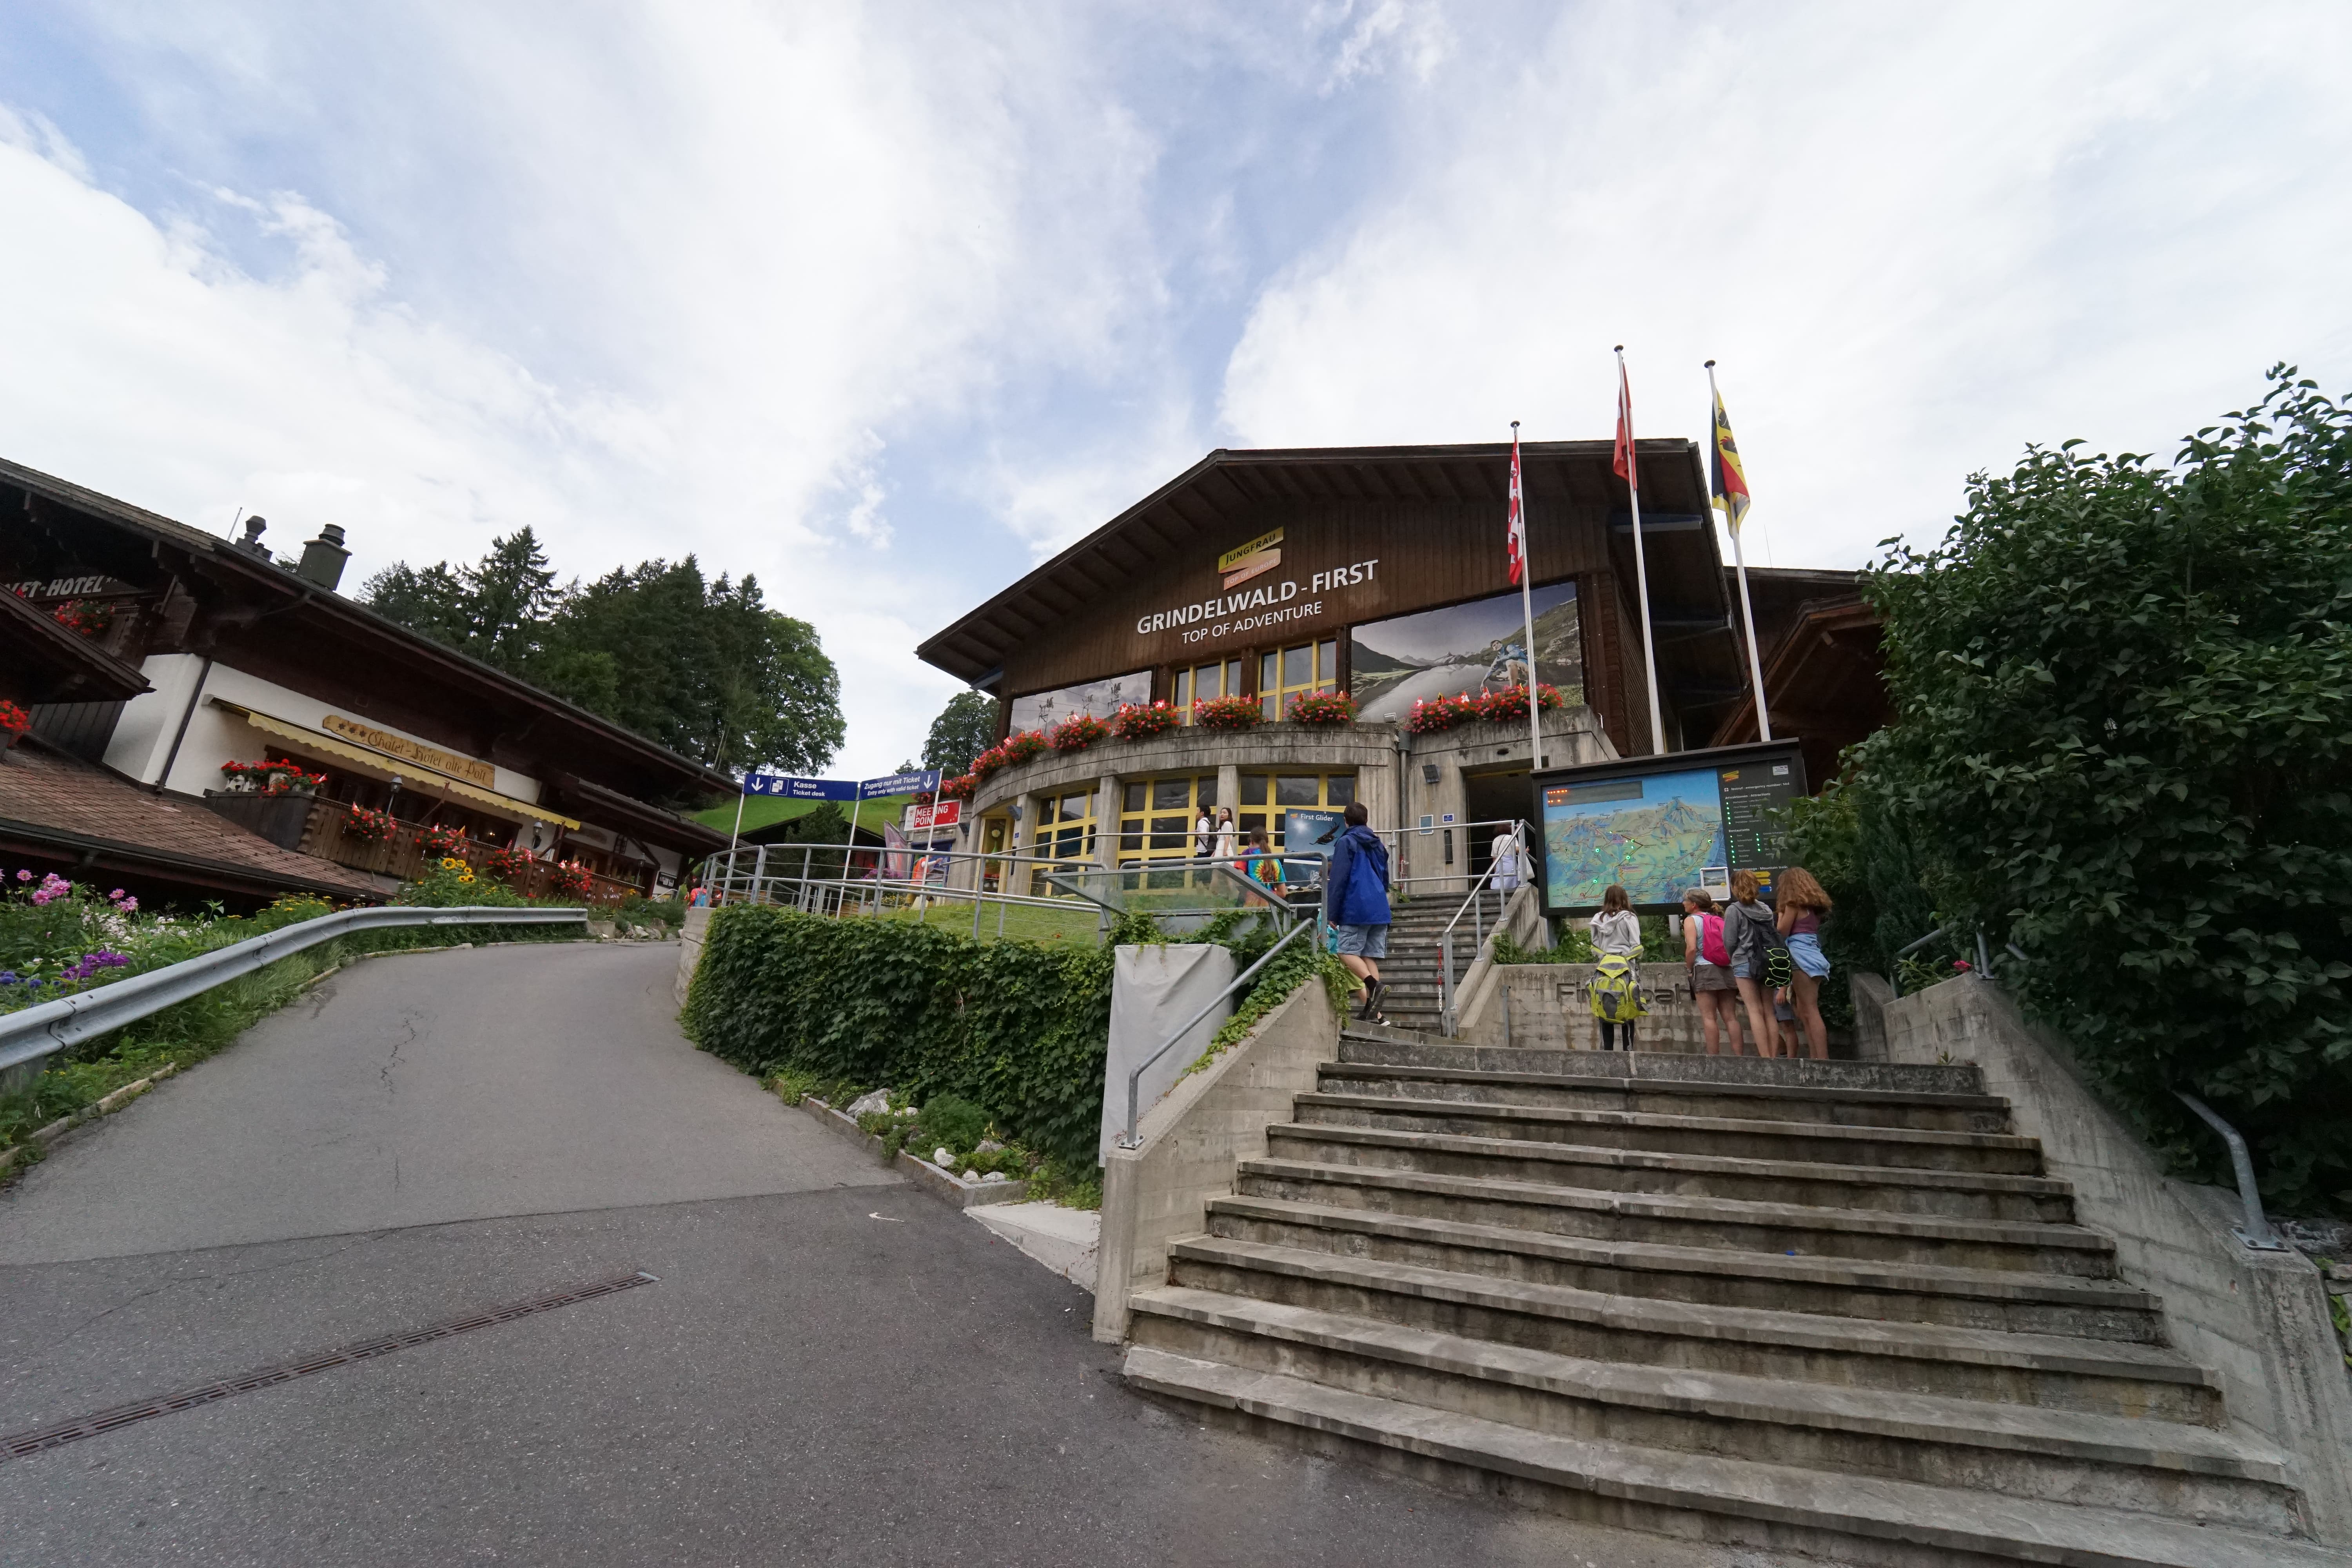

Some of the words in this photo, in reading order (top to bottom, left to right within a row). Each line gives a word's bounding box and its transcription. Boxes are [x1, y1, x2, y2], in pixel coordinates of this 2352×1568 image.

[1225, 533, 1276, 564] JUNGFRAU
[1226, 576, 1239, 586] TOP
[1251, 558, 1277, 574] EUROPE
[1137, 581, 1297, 634] GRINDELWALD
[1312, 559, 1378, 593] FIRST
[1182, 628, 1208, 644] TOP
[1212, 622, 1230, 637] OF
[1233, 601, 1322, 633] ADVENTURE
[445, 759, 462, 773] alte
[794, 781, 817, 789] Kasse
[864, 782, 882, 790] Zugang
[916, 805, 949, 817] MEEING
[915, 815, 937, 826] POIN
